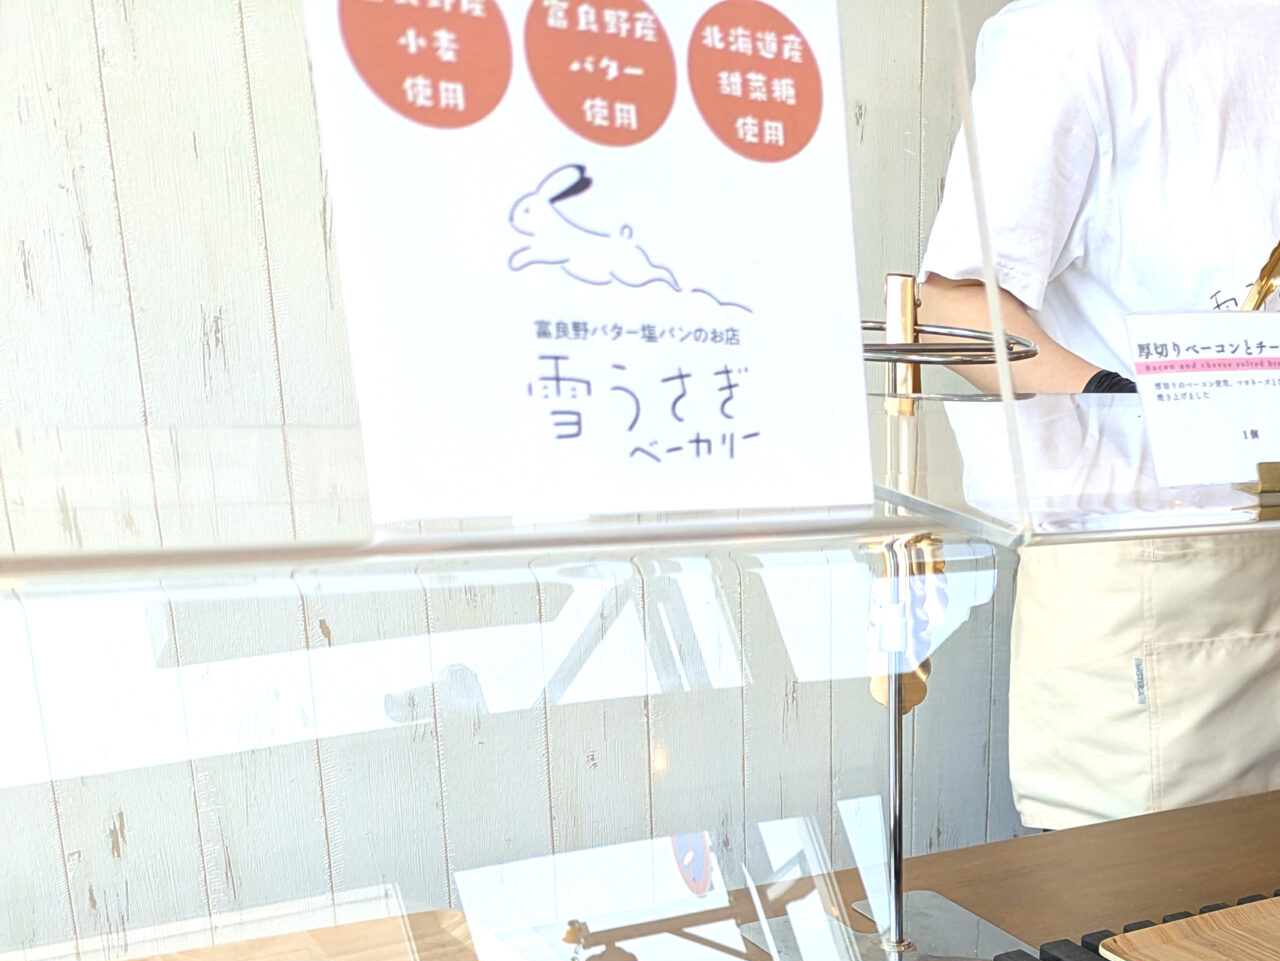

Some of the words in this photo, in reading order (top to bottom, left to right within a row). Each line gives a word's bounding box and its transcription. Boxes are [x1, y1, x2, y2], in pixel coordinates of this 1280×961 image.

[543, 0, 658, 42] 富良野産
[398, 27, 459, 62] 小麦
[701, 24, 804, 63] 北海道産
[568, 55, 645, 81] バター
[402, 75, 466, 111] 使用
[716, 70, 797, 105] 甜菜糖
[582, 97, 639, 130] 使用
[734, 115, 785, 146] 使用
[533, 319, 741, 346] 富良野バター塩パンのお店
[527, 355, 749, 440] 雪うさぎ
[629, 431, 760, 462] ベーカリー
[1242, 429, 1260, 440] 1個
